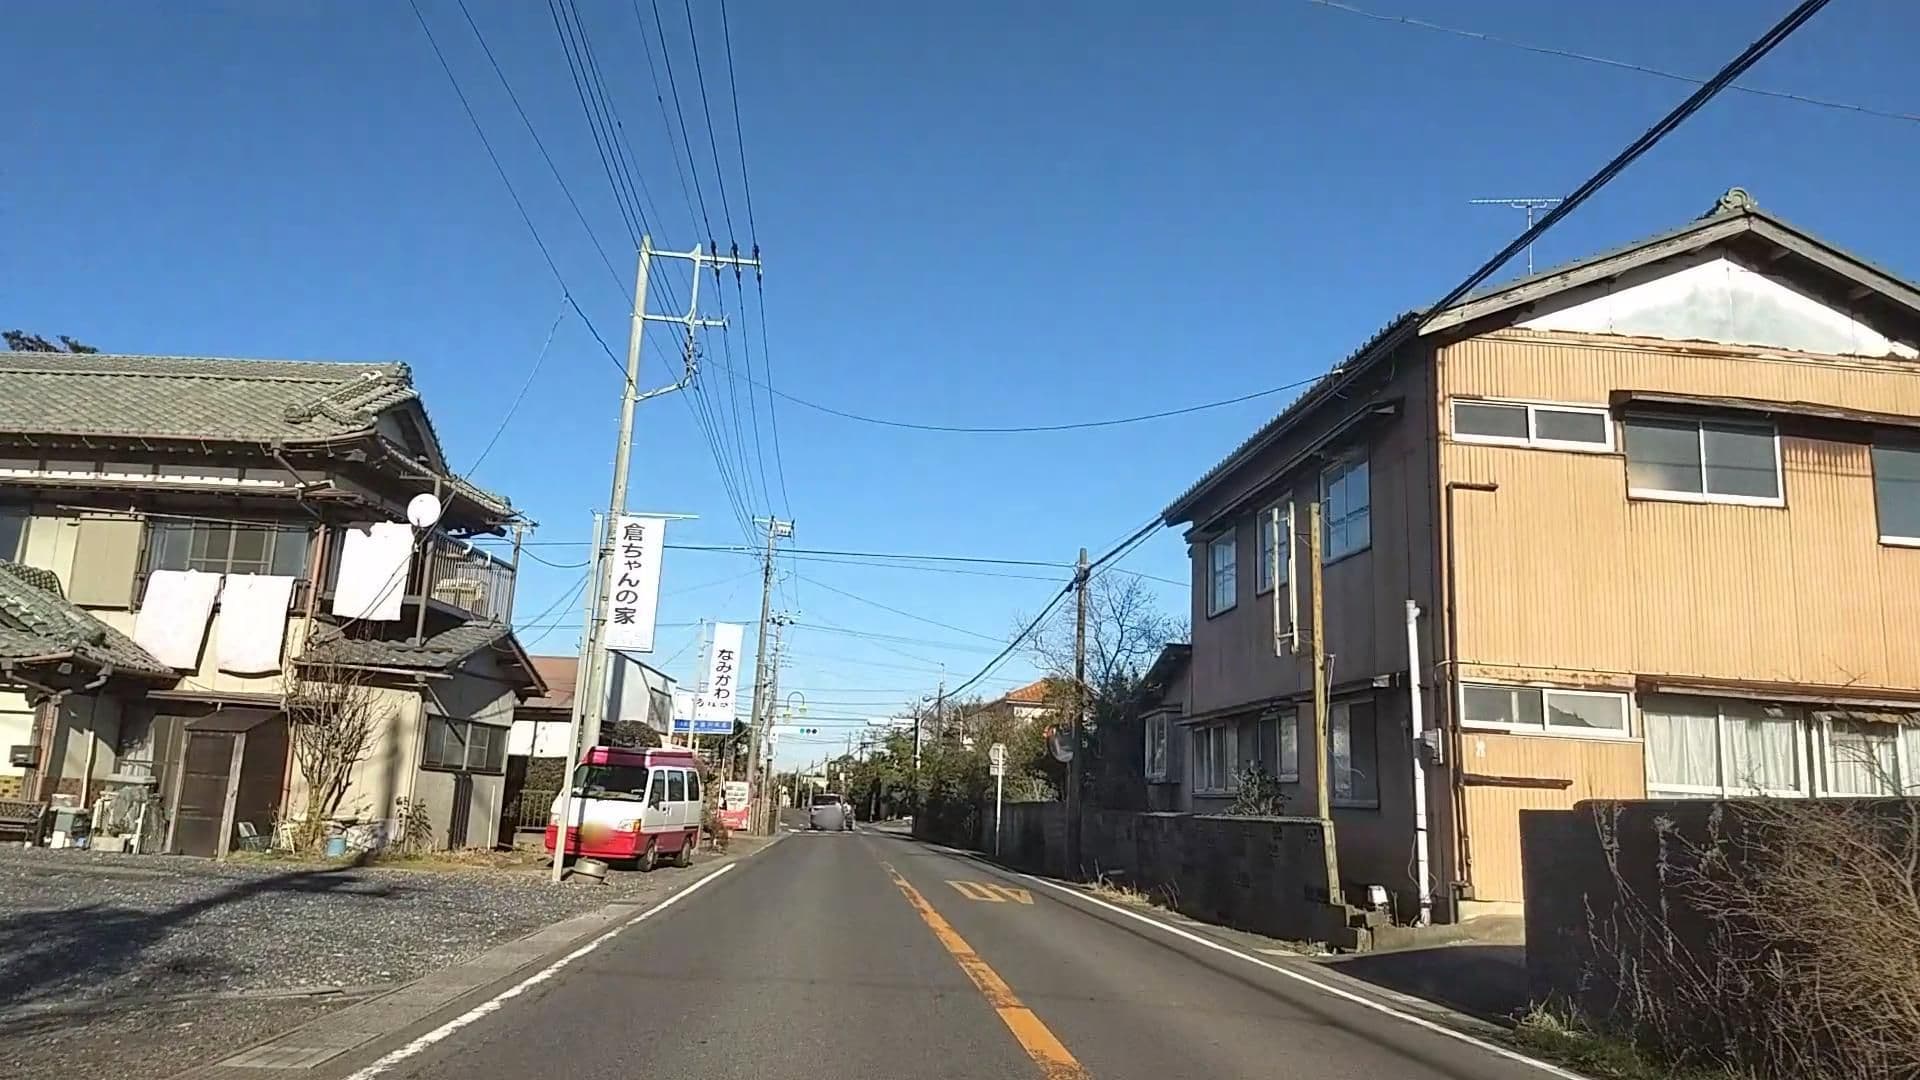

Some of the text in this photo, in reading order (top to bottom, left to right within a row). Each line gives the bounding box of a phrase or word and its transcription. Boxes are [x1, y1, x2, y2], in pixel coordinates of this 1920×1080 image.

[614, 522, 645, 625] 倉ちゃんの家
[714, 648, 734, 699] なみかわ
